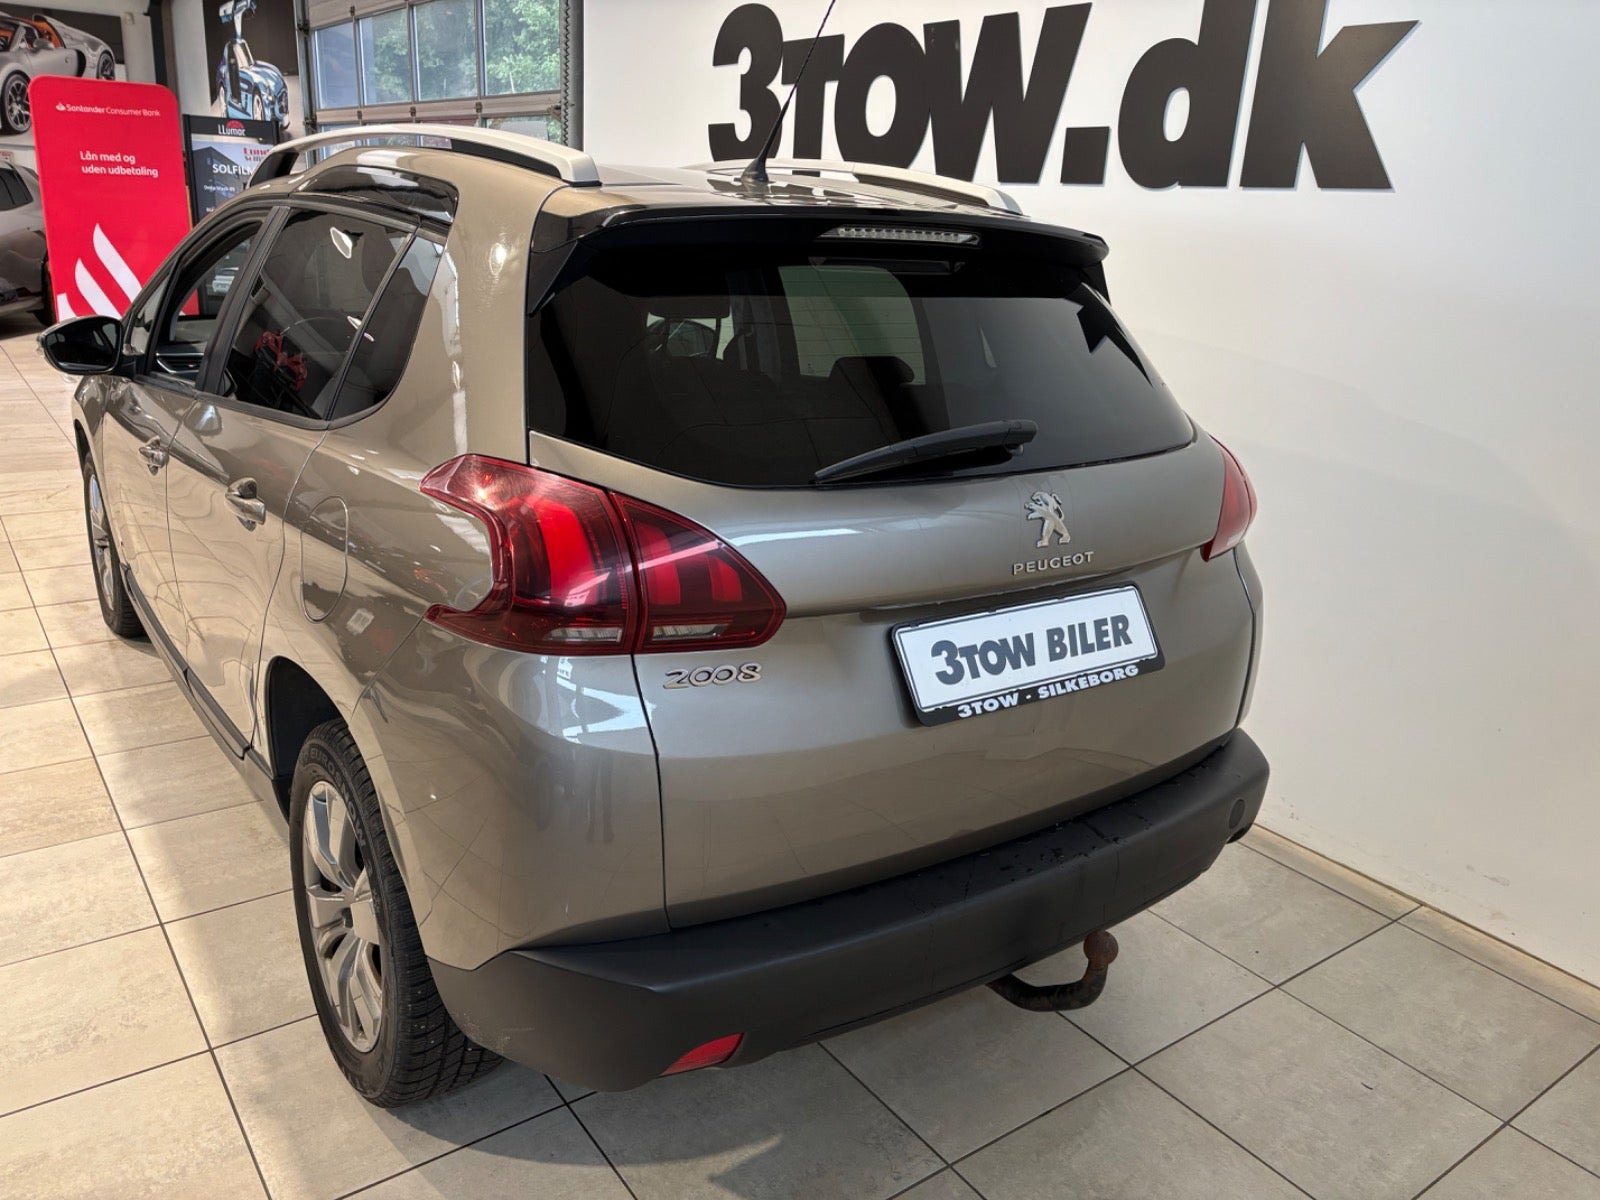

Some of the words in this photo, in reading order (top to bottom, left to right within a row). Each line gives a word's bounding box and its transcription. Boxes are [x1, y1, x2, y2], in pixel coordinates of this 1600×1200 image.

[708, 0, 1419, 191] 3TOW.dk
[66, 104, 105, 114] Santander
[105, 107, 142, 116] Consumer
[142, 109, 160, 117] Bank
[217, 124, 246, 136] LLumar
[79, 150, 98, 160] Lån
[99, 152, 121, 162] med
[122, 155, 136, 165] og
[81, 164, 107, 174] uden
[108, 165, 159, 178] udbetaling
[1013, 551, 1094, 575] PEUGEOT
[931, 632, 1036, 686] 3TOW
[1046, 614, 1133, 662] BILER
[663, 662, 761, 689] 2008
[957, 691, 1019, 718] 3TOW
[1038, 664, 1139, 699] SILKEBORG
